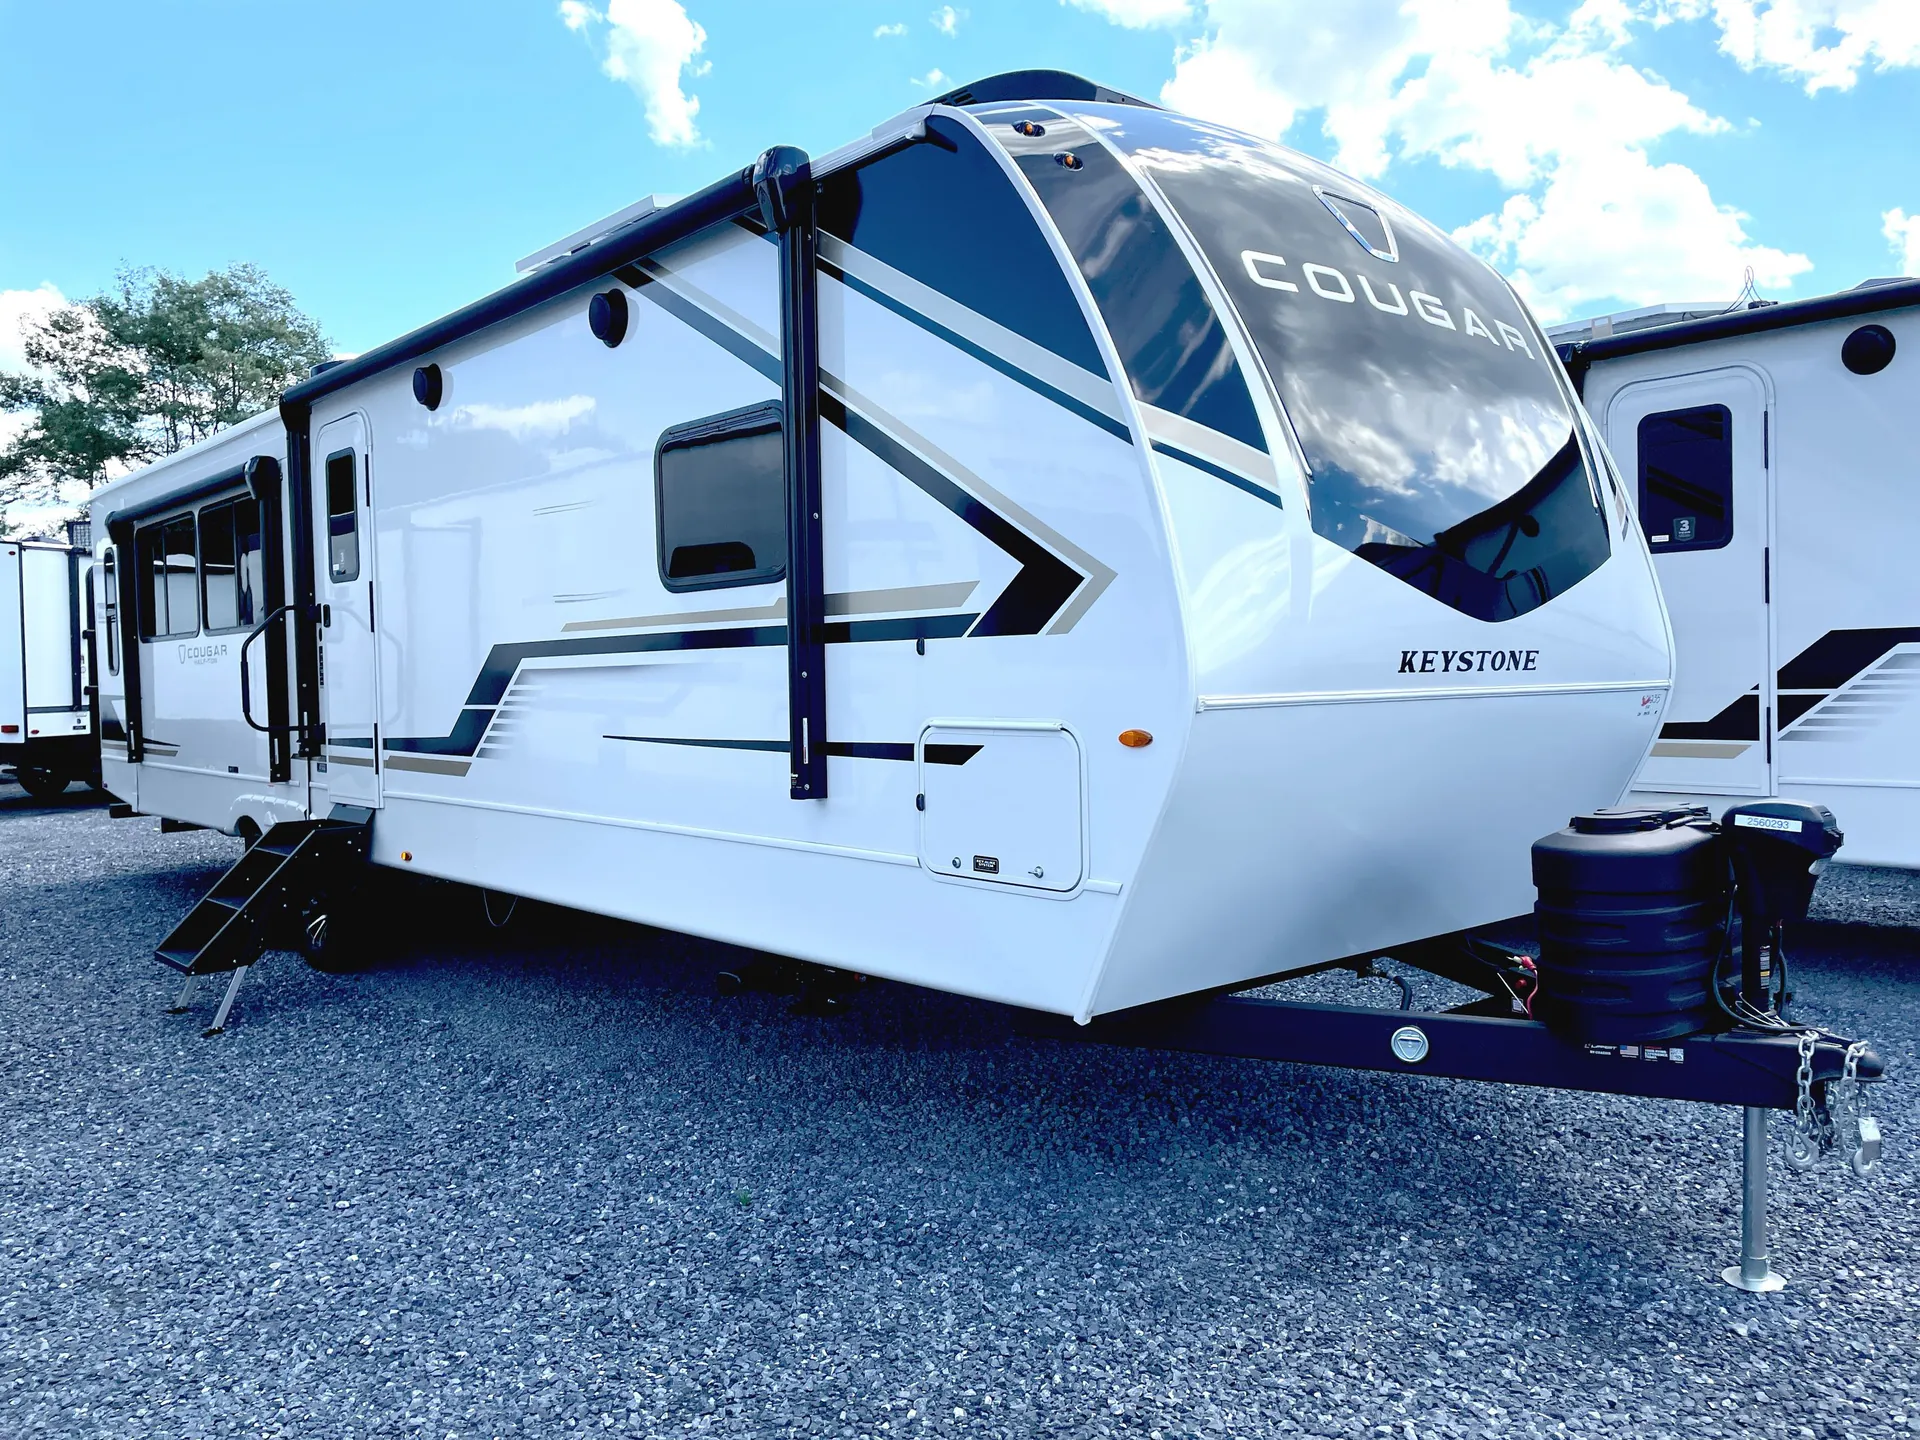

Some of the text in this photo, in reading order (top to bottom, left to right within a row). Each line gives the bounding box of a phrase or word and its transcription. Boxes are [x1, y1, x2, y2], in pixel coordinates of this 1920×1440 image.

[1240, 249, 1536, 360] COUGAR
[1680, 519, 1690, 531] 3
[187, 644, 228, 659] COUGAR
[1397, 650, 1540, 673] KEYSTONE
[1746, 817, 1790, 830] 2560293
